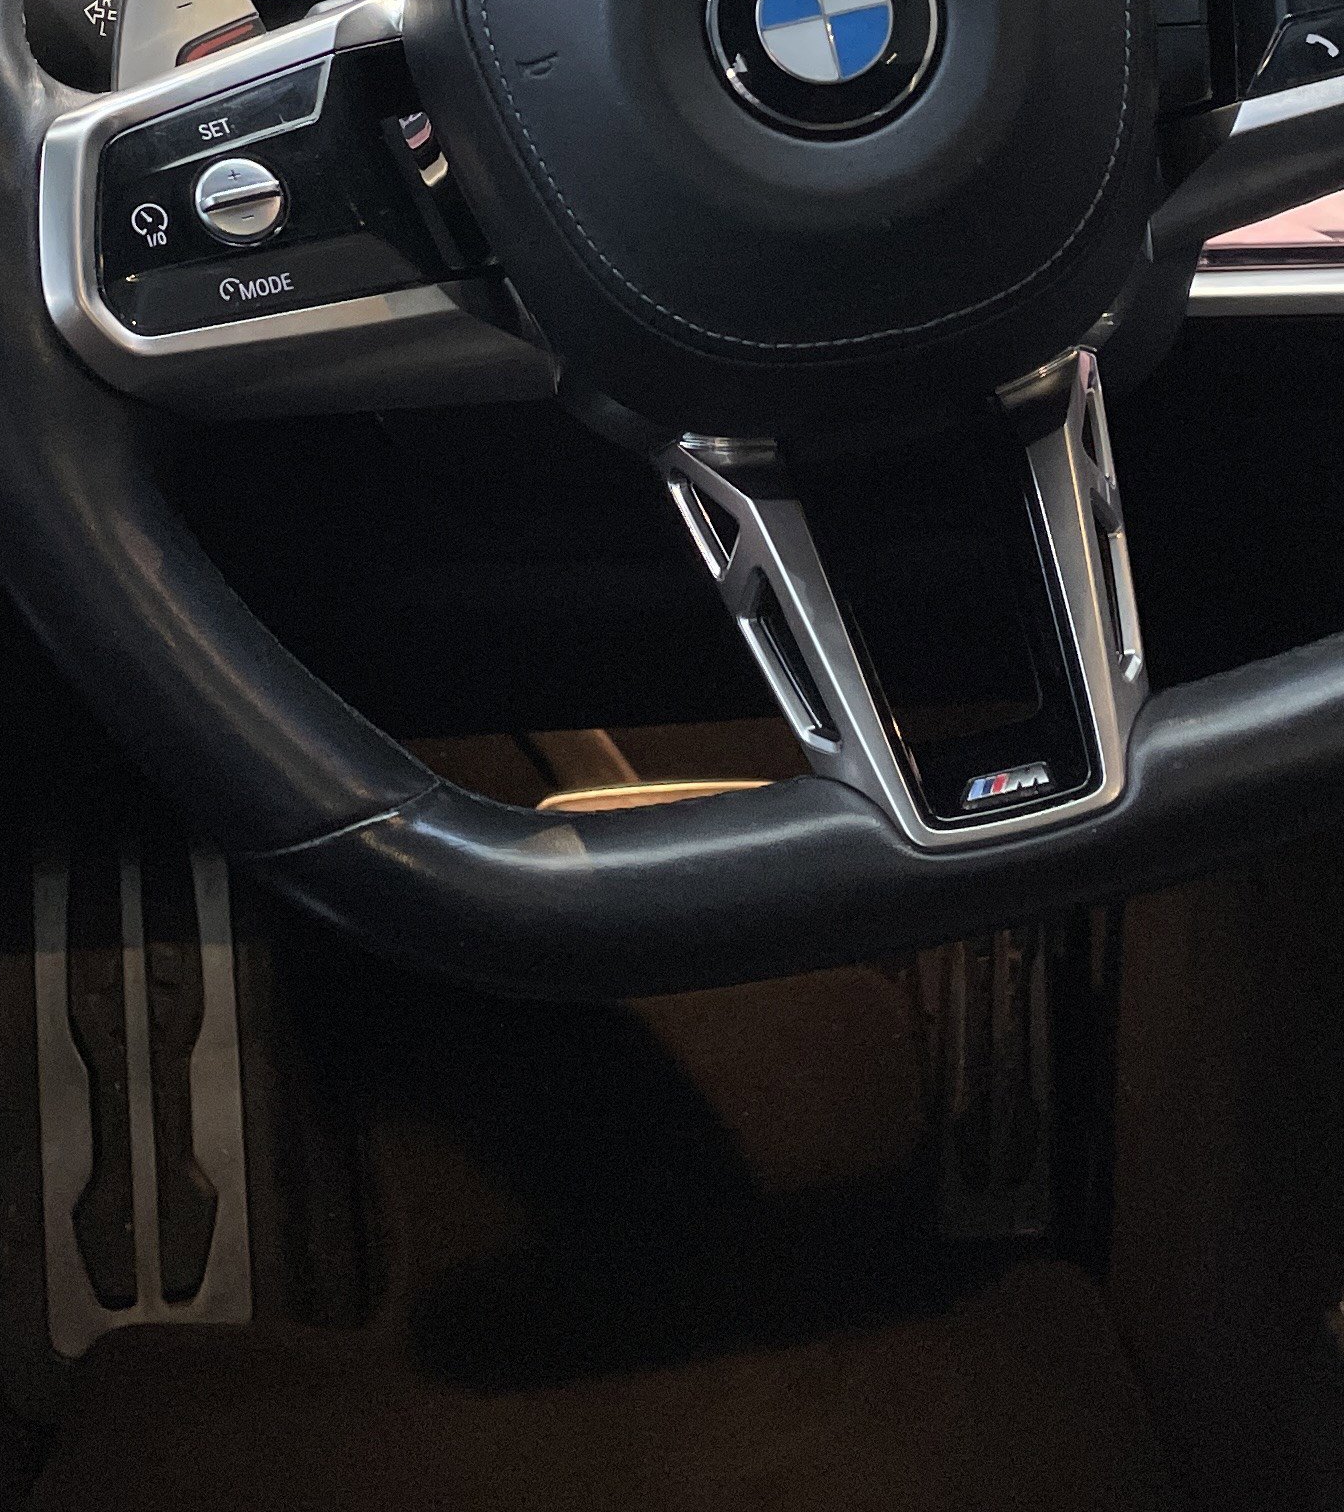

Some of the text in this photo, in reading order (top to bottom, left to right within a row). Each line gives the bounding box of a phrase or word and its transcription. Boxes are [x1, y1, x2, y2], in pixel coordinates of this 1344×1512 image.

[99, 21, 107, 36] L
[198, 117, 231, 141] SET
[238, 272, 294, 300] MODE
